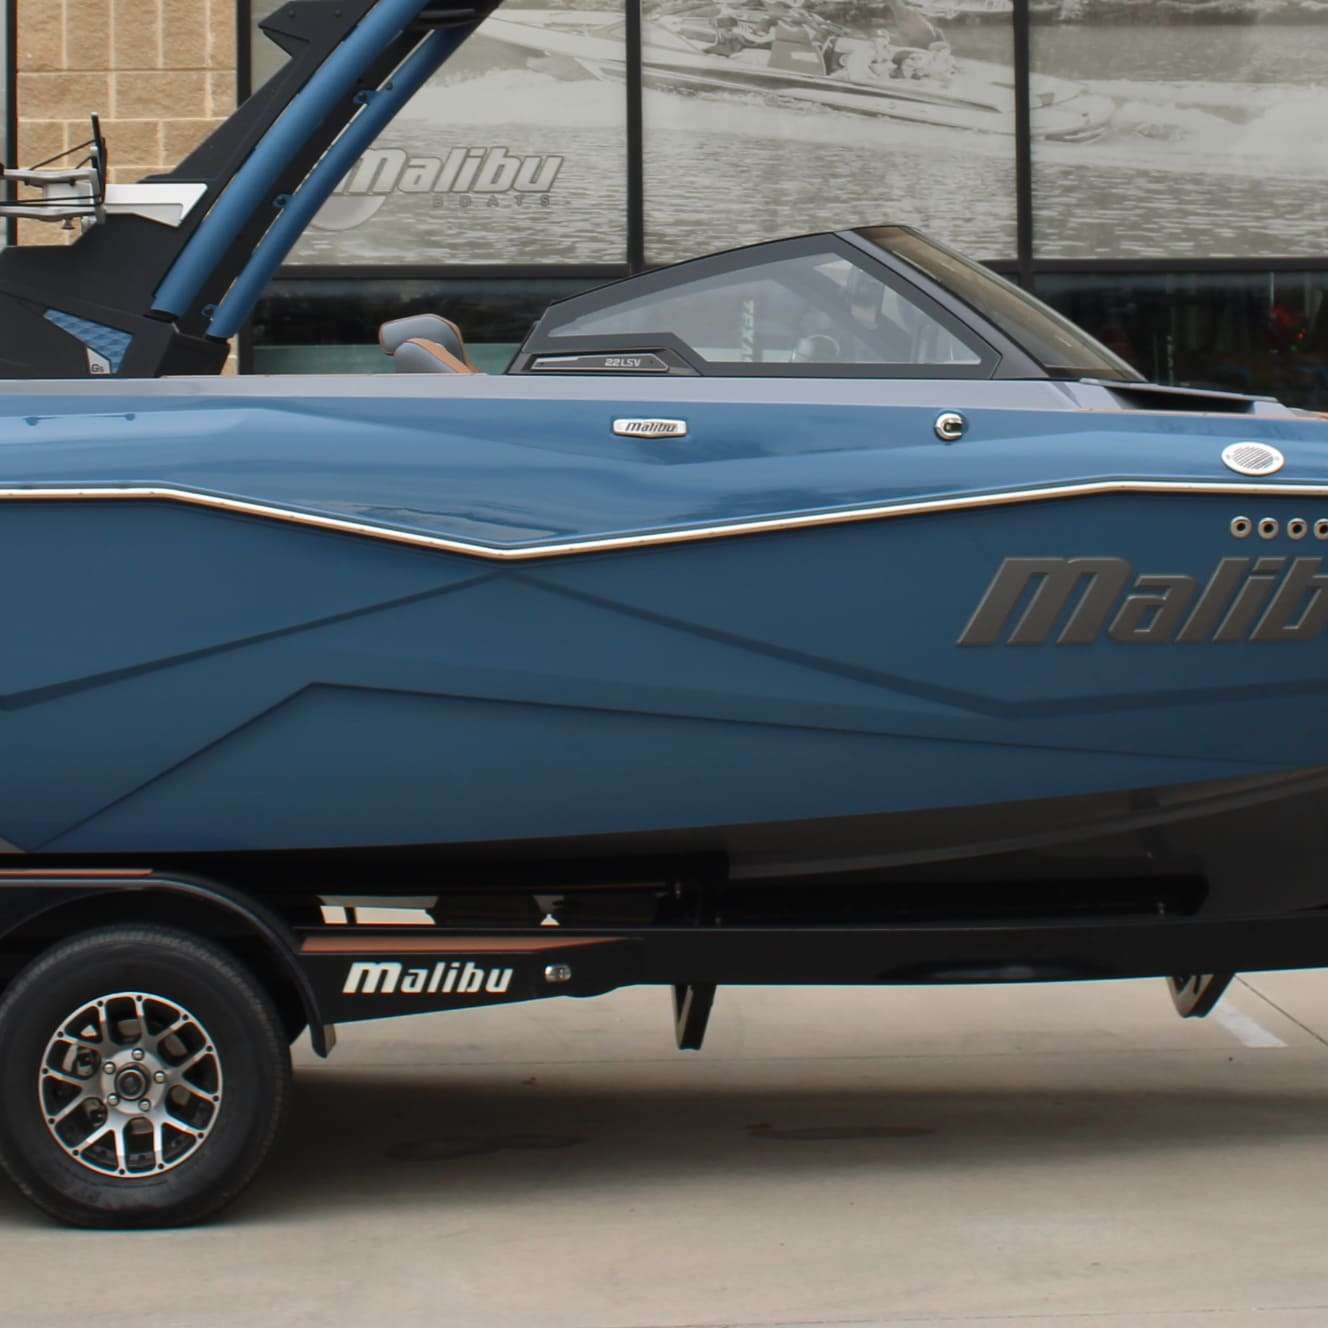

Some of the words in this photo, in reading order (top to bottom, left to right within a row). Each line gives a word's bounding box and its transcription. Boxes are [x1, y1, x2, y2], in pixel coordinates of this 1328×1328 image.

[432, 194, 551, 208] BOATS
[604, 357, 642, 369] 22LSV
[624, 421, 679, 433] Malibu
[341, 961, 514, 994] Malibu
